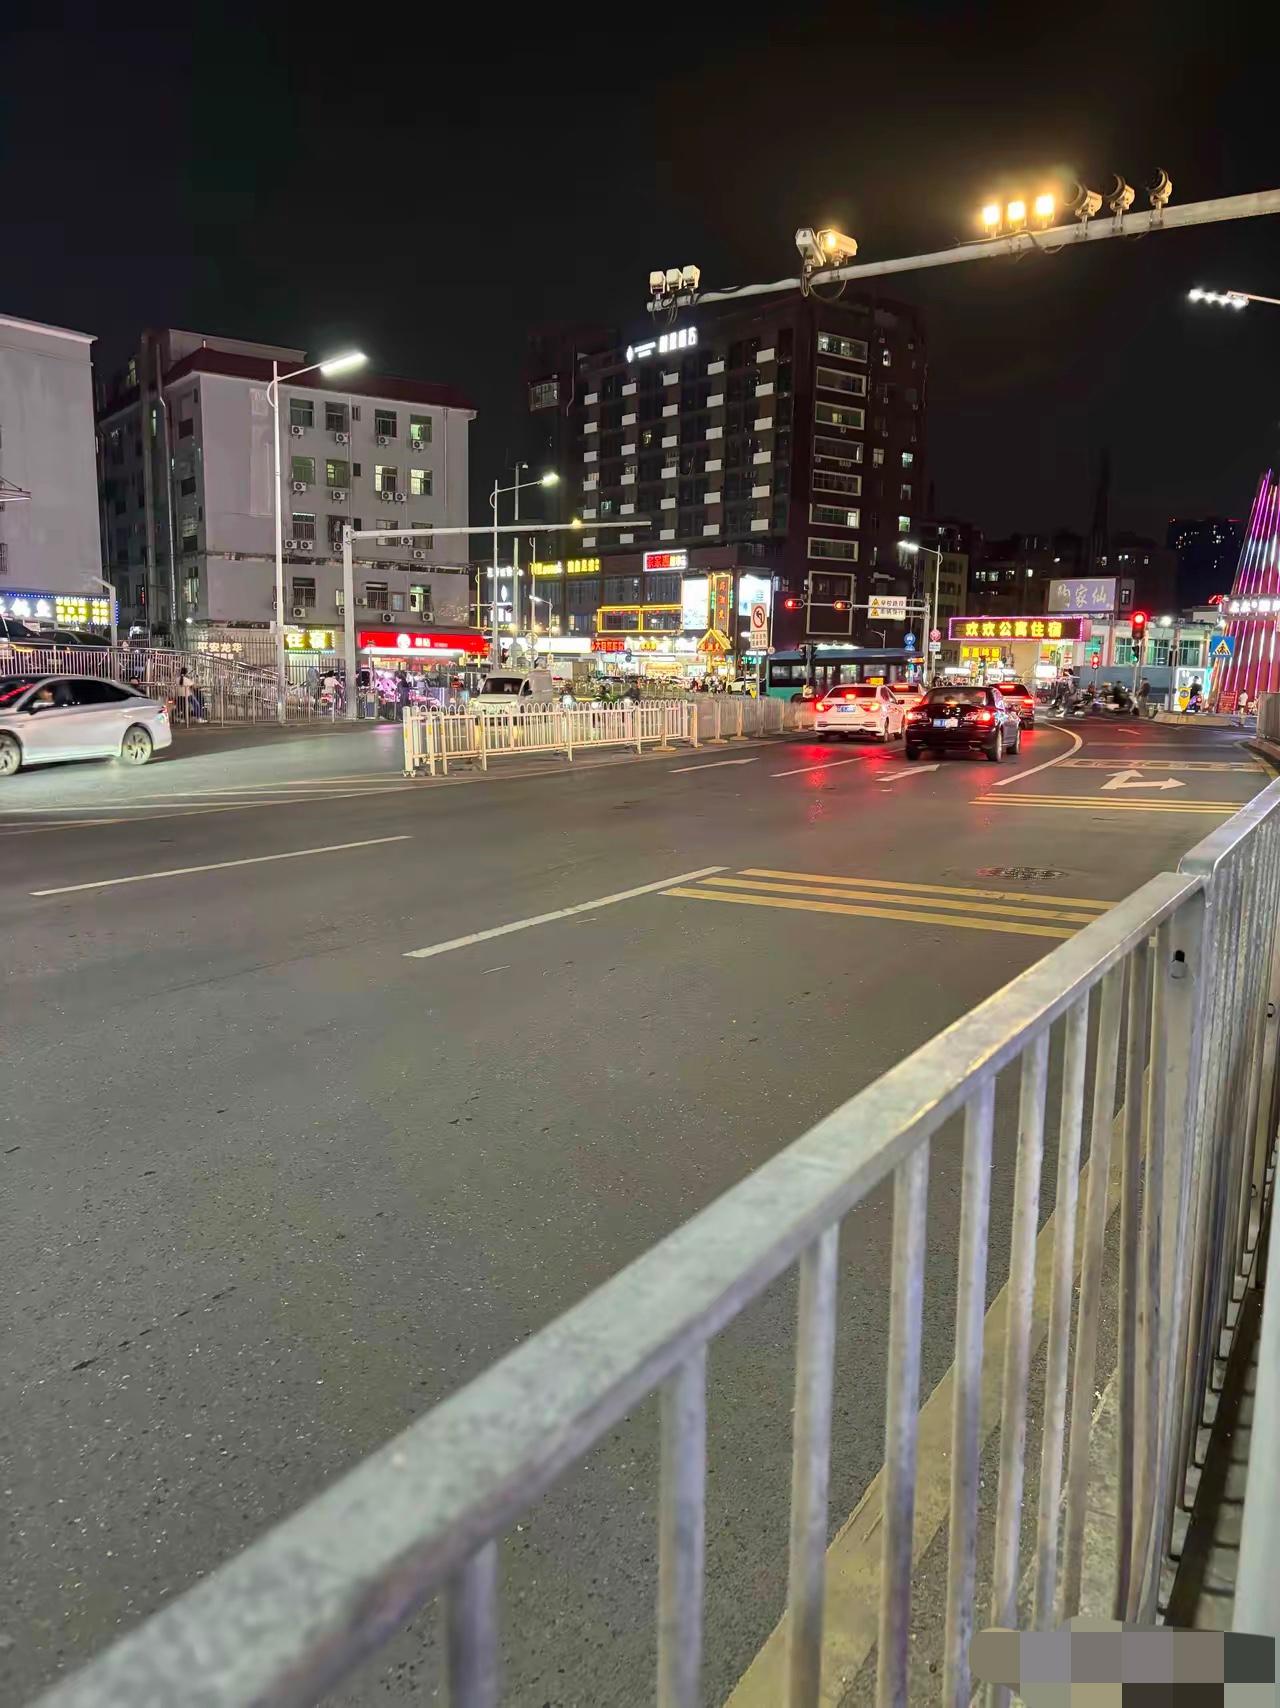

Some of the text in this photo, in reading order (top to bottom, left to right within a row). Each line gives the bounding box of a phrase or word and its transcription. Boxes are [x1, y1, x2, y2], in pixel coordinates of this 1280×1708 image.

[965, 621, 1062, 638] 欢欢公寓住宿
[197, 641, 243, 653] 平安龙华
